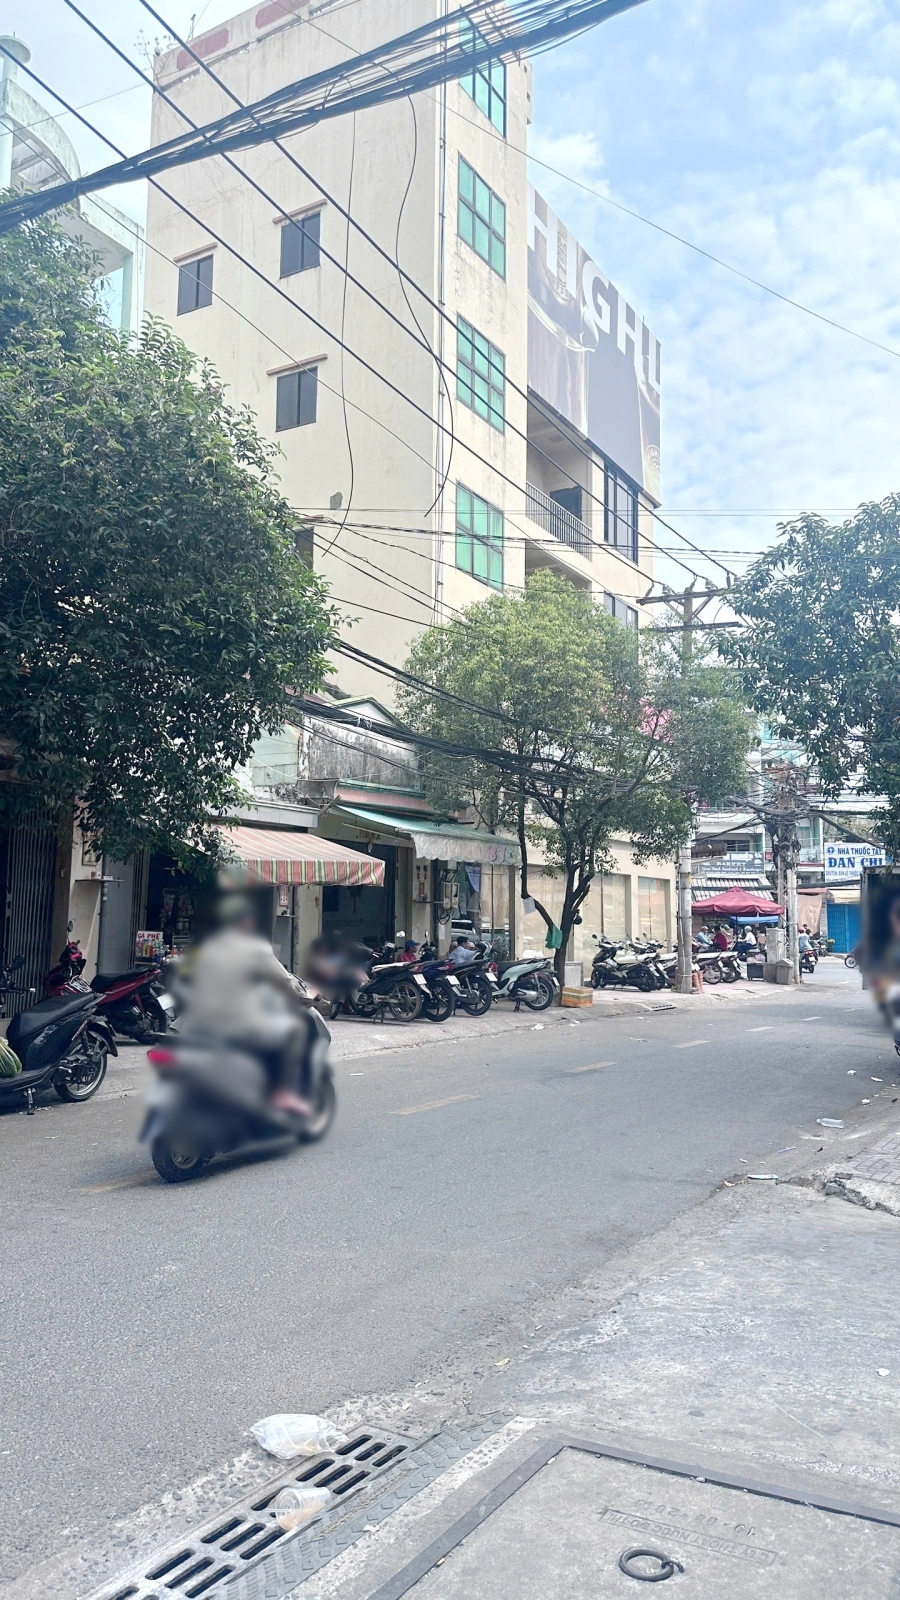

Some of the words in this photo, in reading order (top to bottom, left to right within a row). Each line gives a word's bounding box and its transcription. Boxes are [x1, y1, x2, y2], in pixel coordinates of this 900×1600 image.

[486, 846, 506, 862] 87
[837, 845, 850, 855] NHÀ
[851, 844, 871, 855] THUỐC
[828, 857, 855, 868] ĐAN
